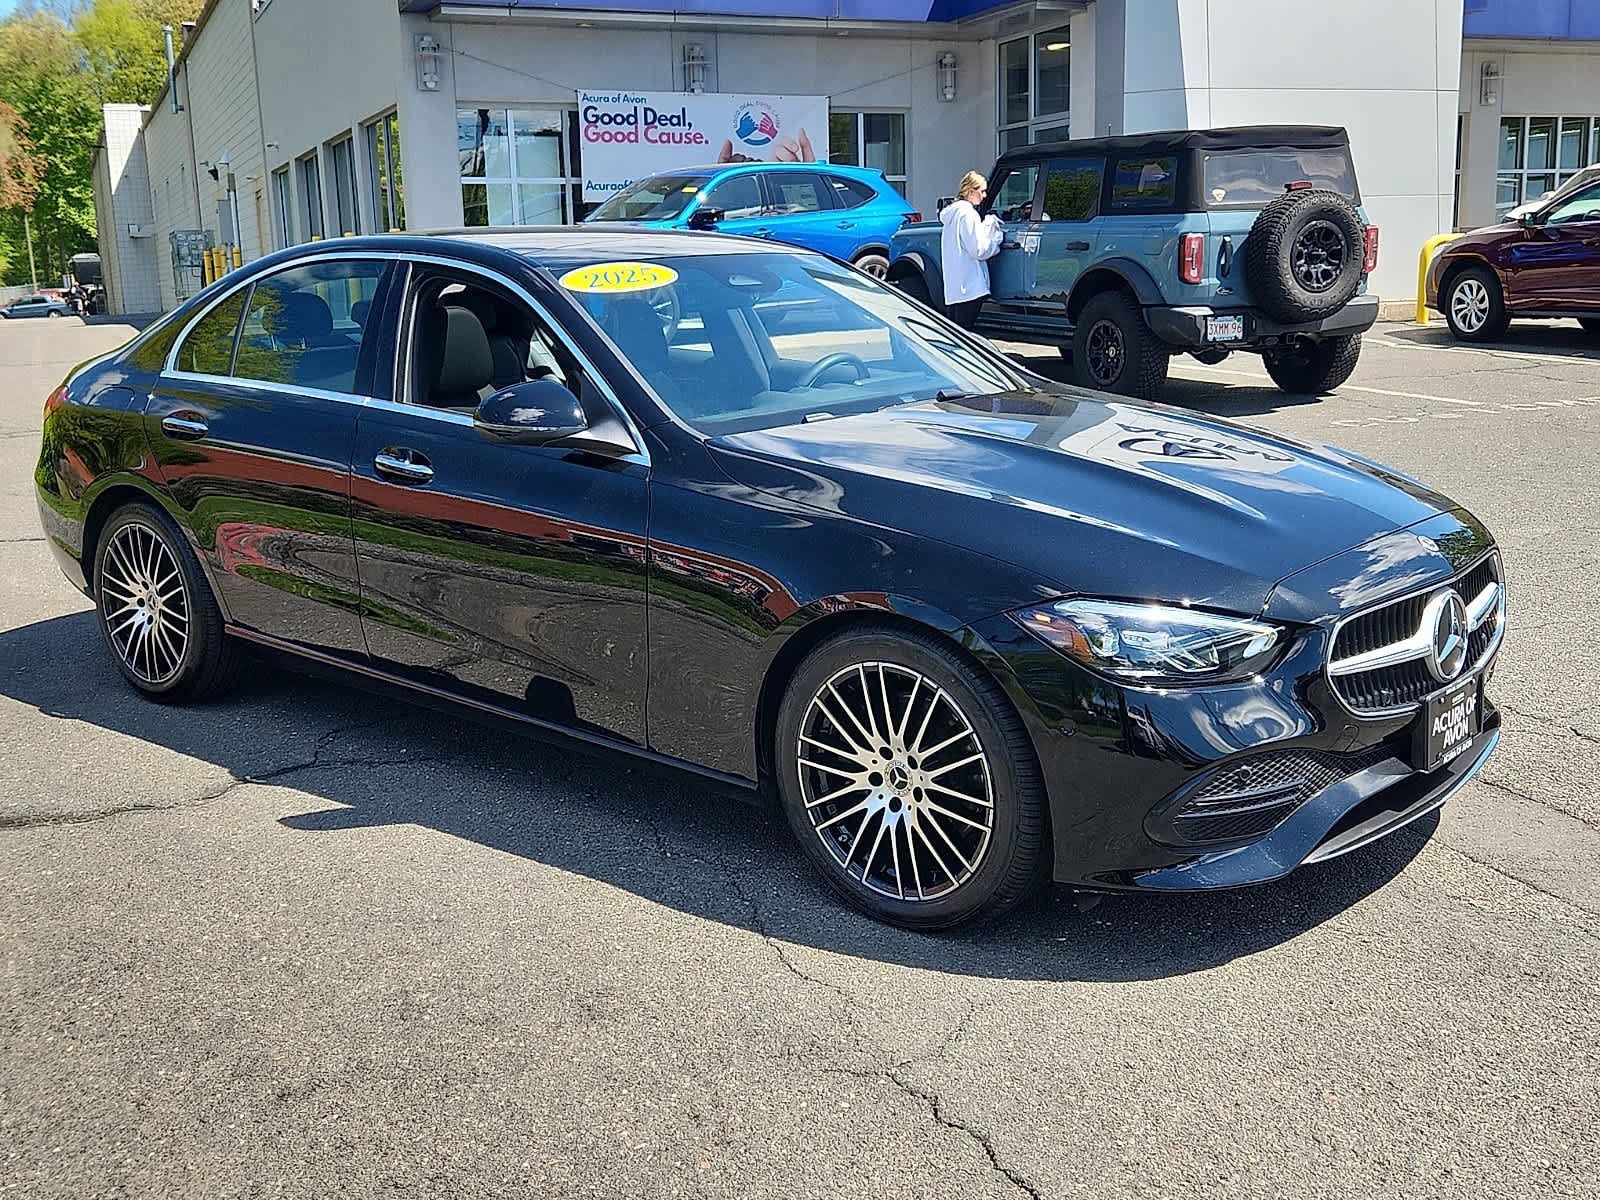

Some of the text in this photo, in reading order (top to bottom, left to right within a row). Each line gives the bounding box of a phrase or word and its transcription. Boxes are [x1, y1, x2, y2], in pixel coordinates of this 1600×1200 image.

[582, 93, 647, 104] Acura of Avon
[583, 105, 692, 130] Good Deal,
[584, 123, 709, 145] Good Cause.
[583, 267, 658, 288] 2025
[1231, 321, 1242, 334] 96
[1432, 692, 1477, 737] ACURA OF
[1443, 716, 1469, 749] AVON
